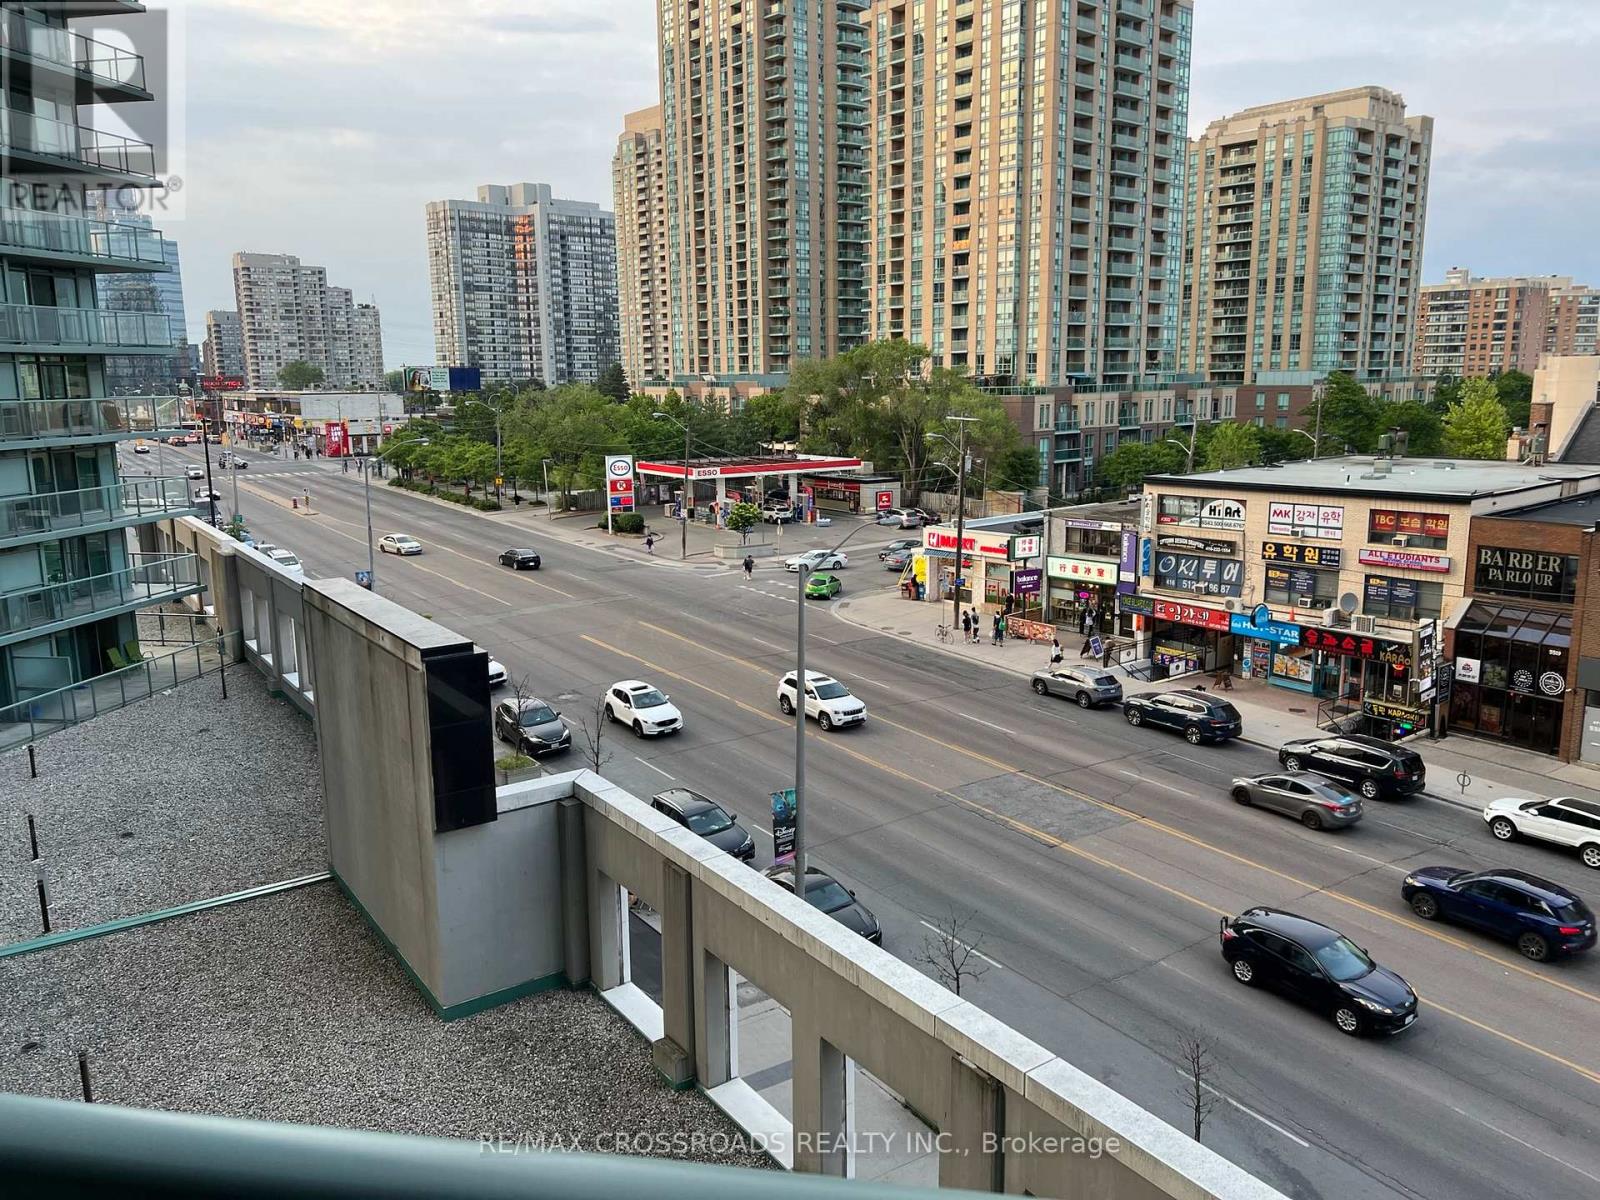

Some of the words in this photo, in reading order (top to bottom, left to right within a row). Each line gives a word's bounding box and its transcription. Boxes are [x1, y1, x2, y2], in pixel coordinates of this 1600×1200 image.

[697, 469, 718, 477] ESSO
[1208, 504, 1221, 516] Hi
[1225, 507, 1241, 518] Art
[1272, 509, 1291, 518] MK
[1321, 511, 1341, 524] 유학
[1263, 543, 1319, 564] 유학원
[1368, 550, 1382, 558] ALL
[1389, 552, 1440, 564] ETUDIANTS
[1480, 549, 1560, 573] BARBER
[1202, 560, 1240, 582] 투어
[1488, 568, 1553, 587] PARLOUR
[1016, 575, 1038, 583] balance
[1220, 585, 1231, 594] 87
